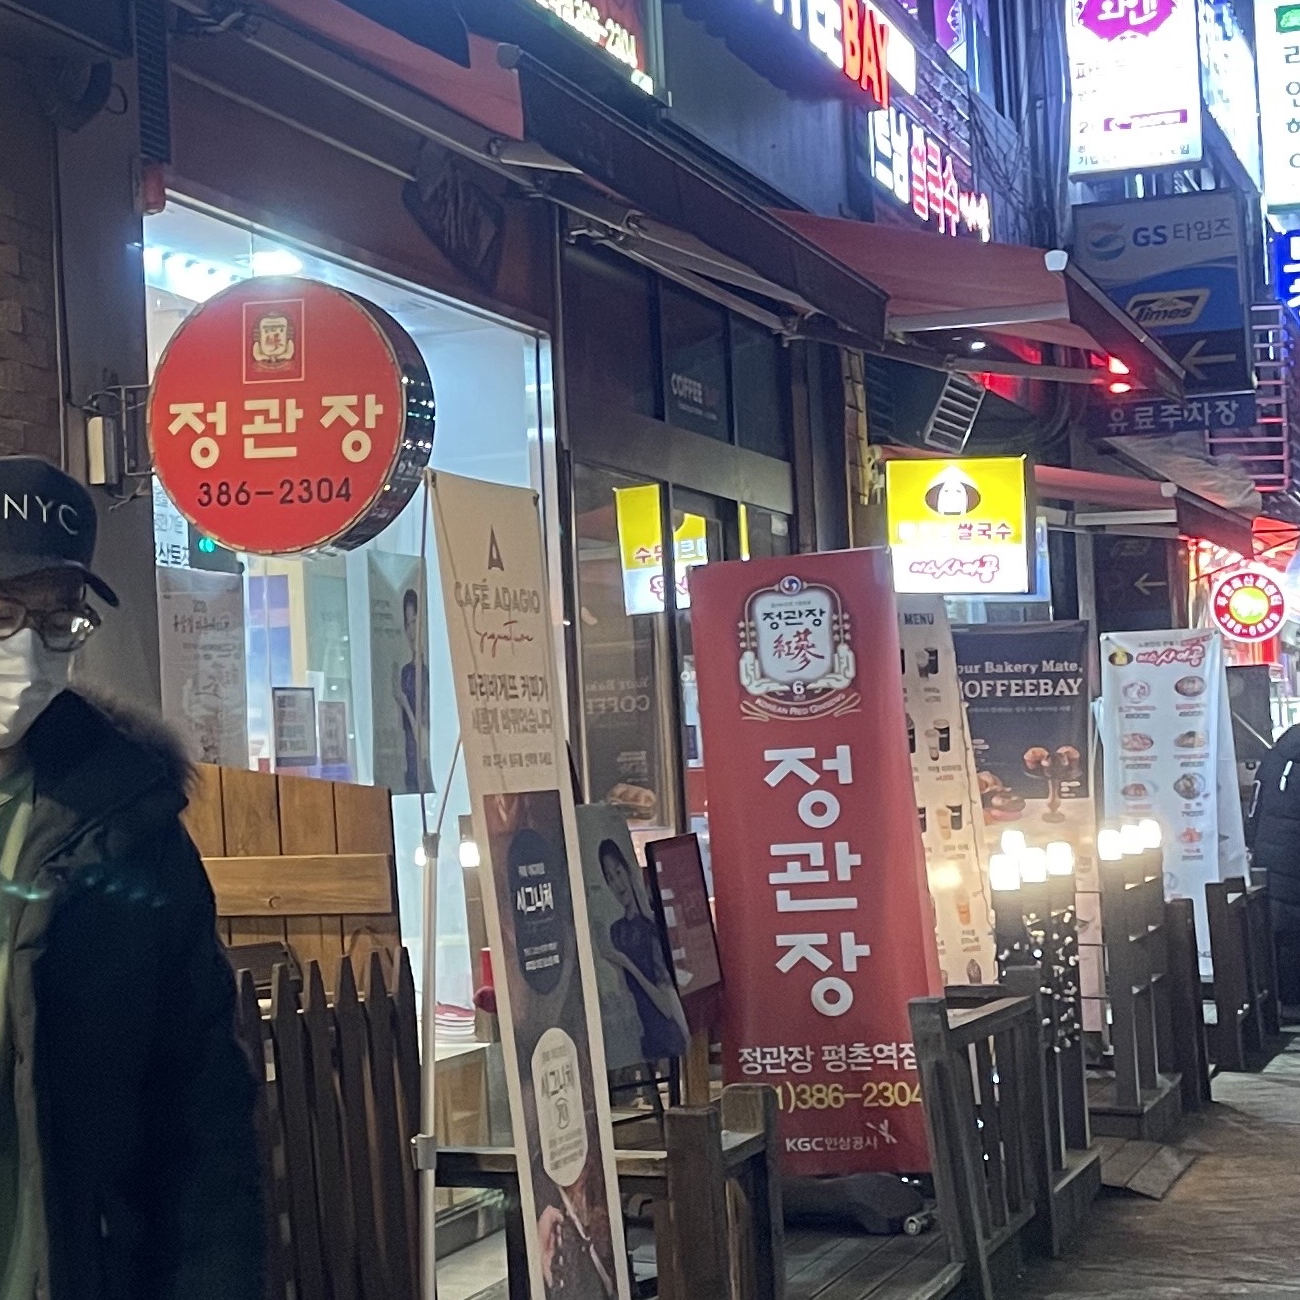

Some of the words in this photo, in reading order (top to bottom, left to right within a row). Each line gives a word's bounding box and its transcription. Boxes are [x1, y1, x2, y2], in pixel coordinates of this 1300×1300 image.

[1132, 225, 1168, 248] GS
[1173, 217, 1233, 242] 타임즈
[167, 394, 384, 469] 정관장
[1108, 400, 1240, 433] 유료주차장
[197, 477, 352, 508] 386-2304
[3, 493, 79, 536] NYC
[454, 578, 490, 611] CAFÉ
[493, 585, 541, 615] ADAGIO
[762, 608, 826, 630] 정관장
[904, 612, 934, 625] MENU
[957, 664, 981, 674] our
[984, 661, 1039, 675] Bakery
[792, 680, 805, 695] 6
[958, 677, 1084, 699] OFFEEBAY
[763, 744, 871, 1017] 정관장
[738, 1045, 815, 1075] 정관장
[775, 1081, 923, 1114] 1)386-2304
[785, 1136, 878, 1153] KGC인삼공사
